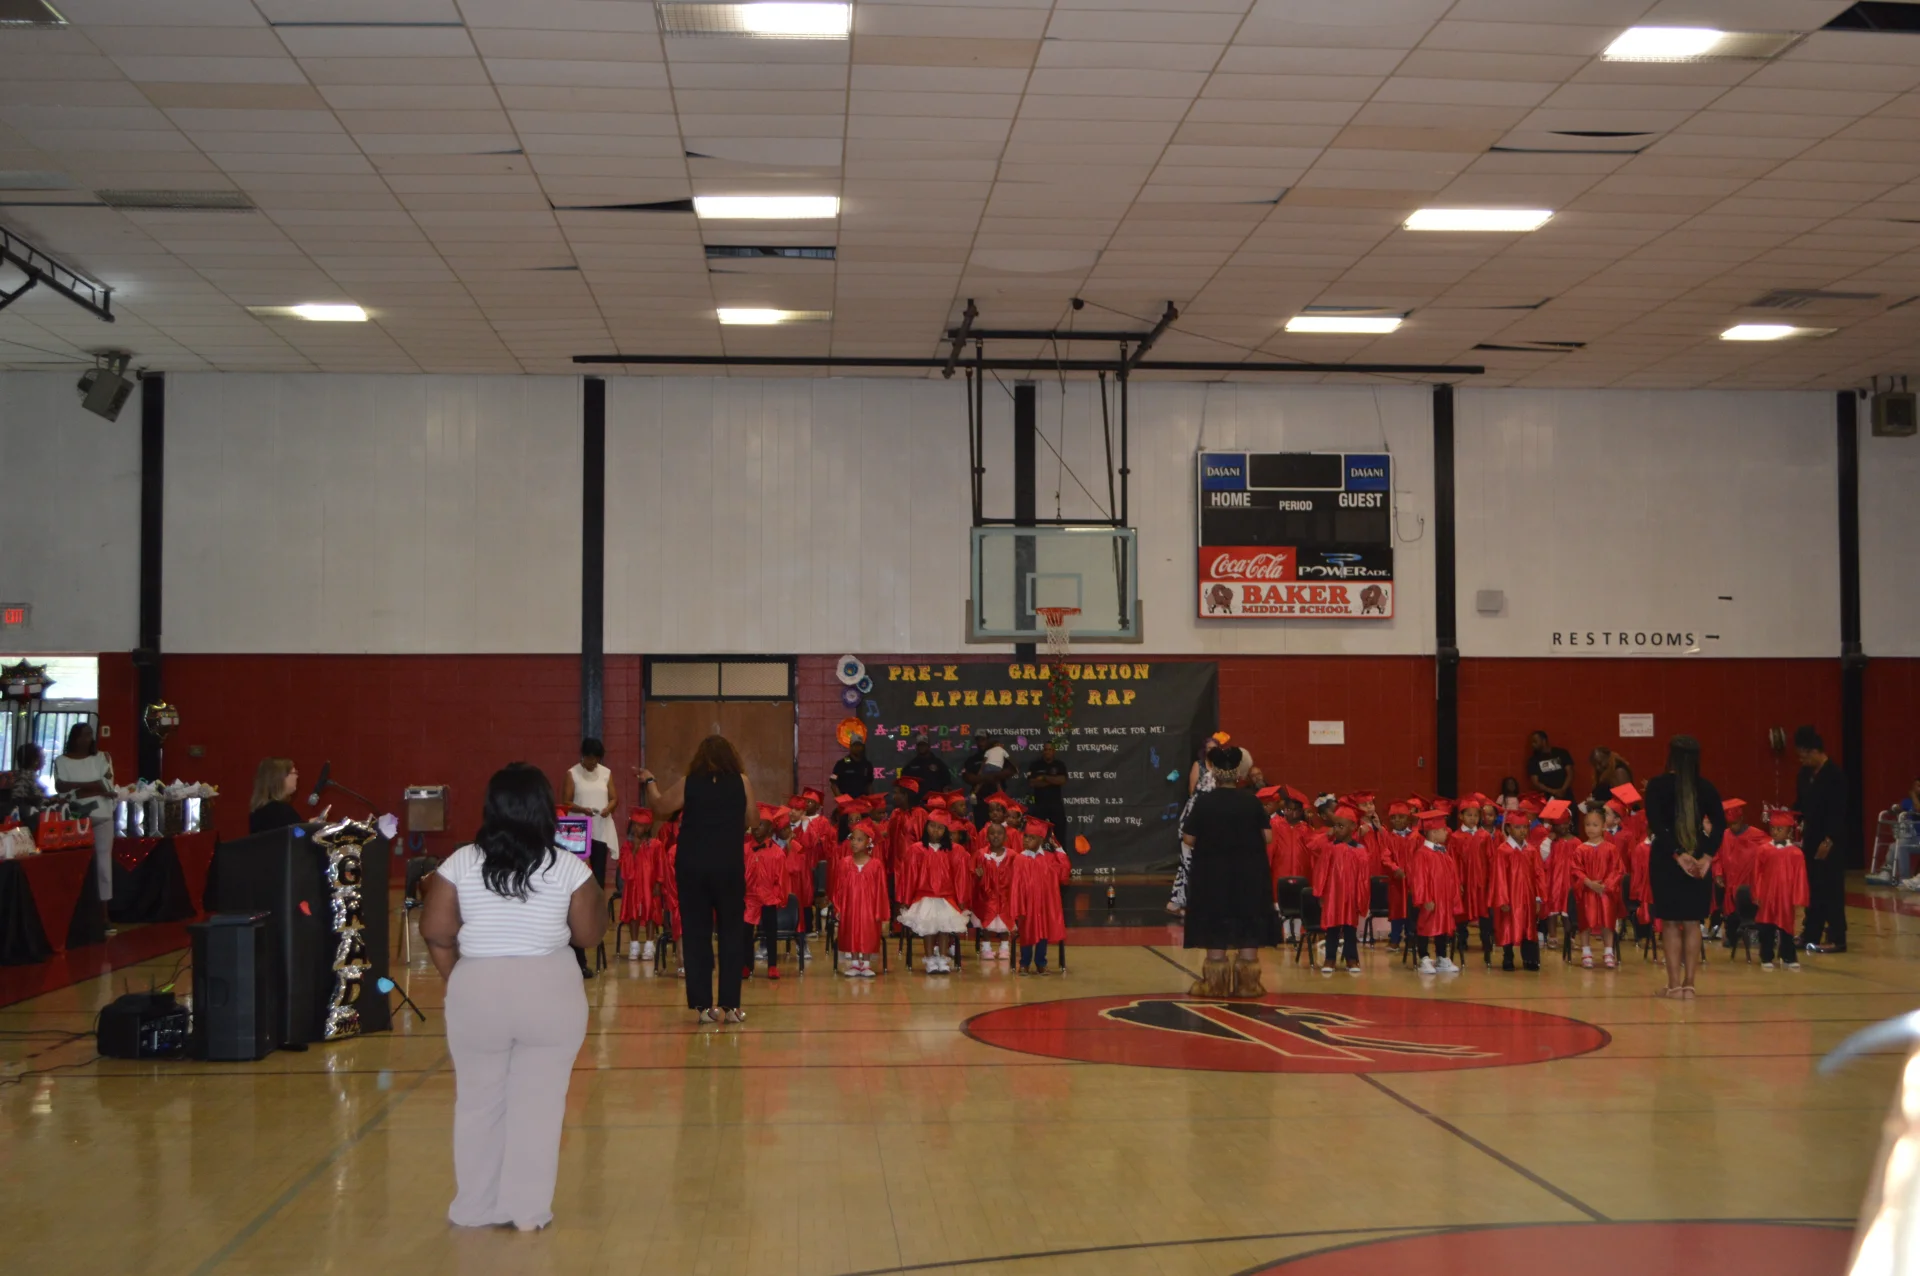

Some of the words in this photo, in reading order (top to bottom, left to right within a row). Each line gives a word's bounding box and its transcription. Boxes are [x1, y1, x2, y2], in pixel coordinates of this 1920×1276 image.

[1207, 467, 1240, 477] DASANI
[1350, 468, 1384, 478] DASANI
[1211, 492, 1251, 507] HOME
[1339, 493, 1383, 508] GUEST
[1279, 500, 1313, 511] PERIOD
[1210, 553, 1288, 580] Coca-Cola
[1298, 566, 1388, 578] POWERADE
[1242, 585, 1351, 604] BAKER
[1241, 605, 1295, 614] MIDDLE
[1299, 605, 1352, 614] SCHOOL
[1552, 632, 1695, 646] RESTROOMS
[888, 664, 959, 682] PRE-K
[1008, 663, 1150, 680] GRAUATION
[914, 689, 1043, 707] ALPHABET
[1087, 689, 1136, 706] RAP
[987, 727, 1041, 736] NDERGARTEN
[1084, 727, 1099, 735] THE
[1103, 727, 1127, 735] PLACE
[1130, 726, 1146, 734] FOR
[1067, 771, 1084, 779] ERE
[1088, 771, 1101, 779] WE
[1063, 796, 1101, 805] NUMBERS
[1104, 816, 1121, 824] AND
